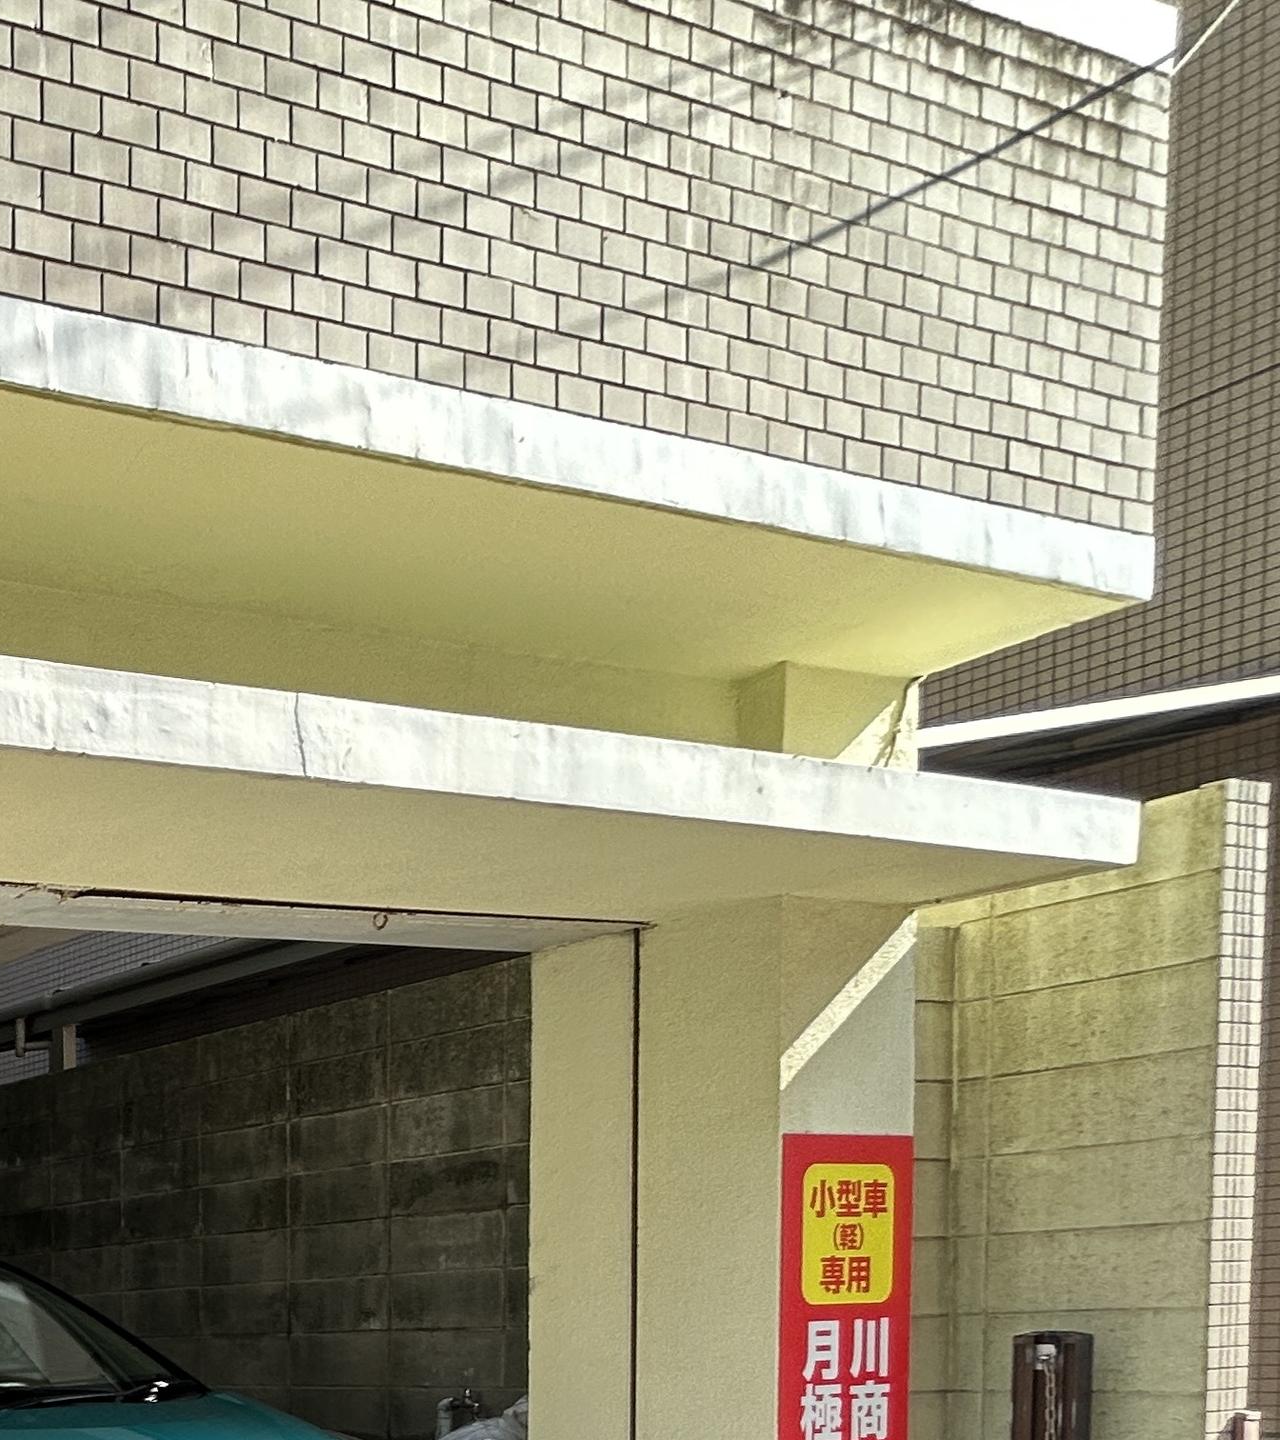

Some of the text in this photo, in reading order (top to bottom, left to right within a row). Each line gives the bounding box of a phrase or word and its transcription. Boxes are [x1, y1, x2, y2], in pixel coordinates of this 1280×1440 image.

[809, 1179, 888, 1218] 小型車
[819, 1255, 871, 1294] 専用
